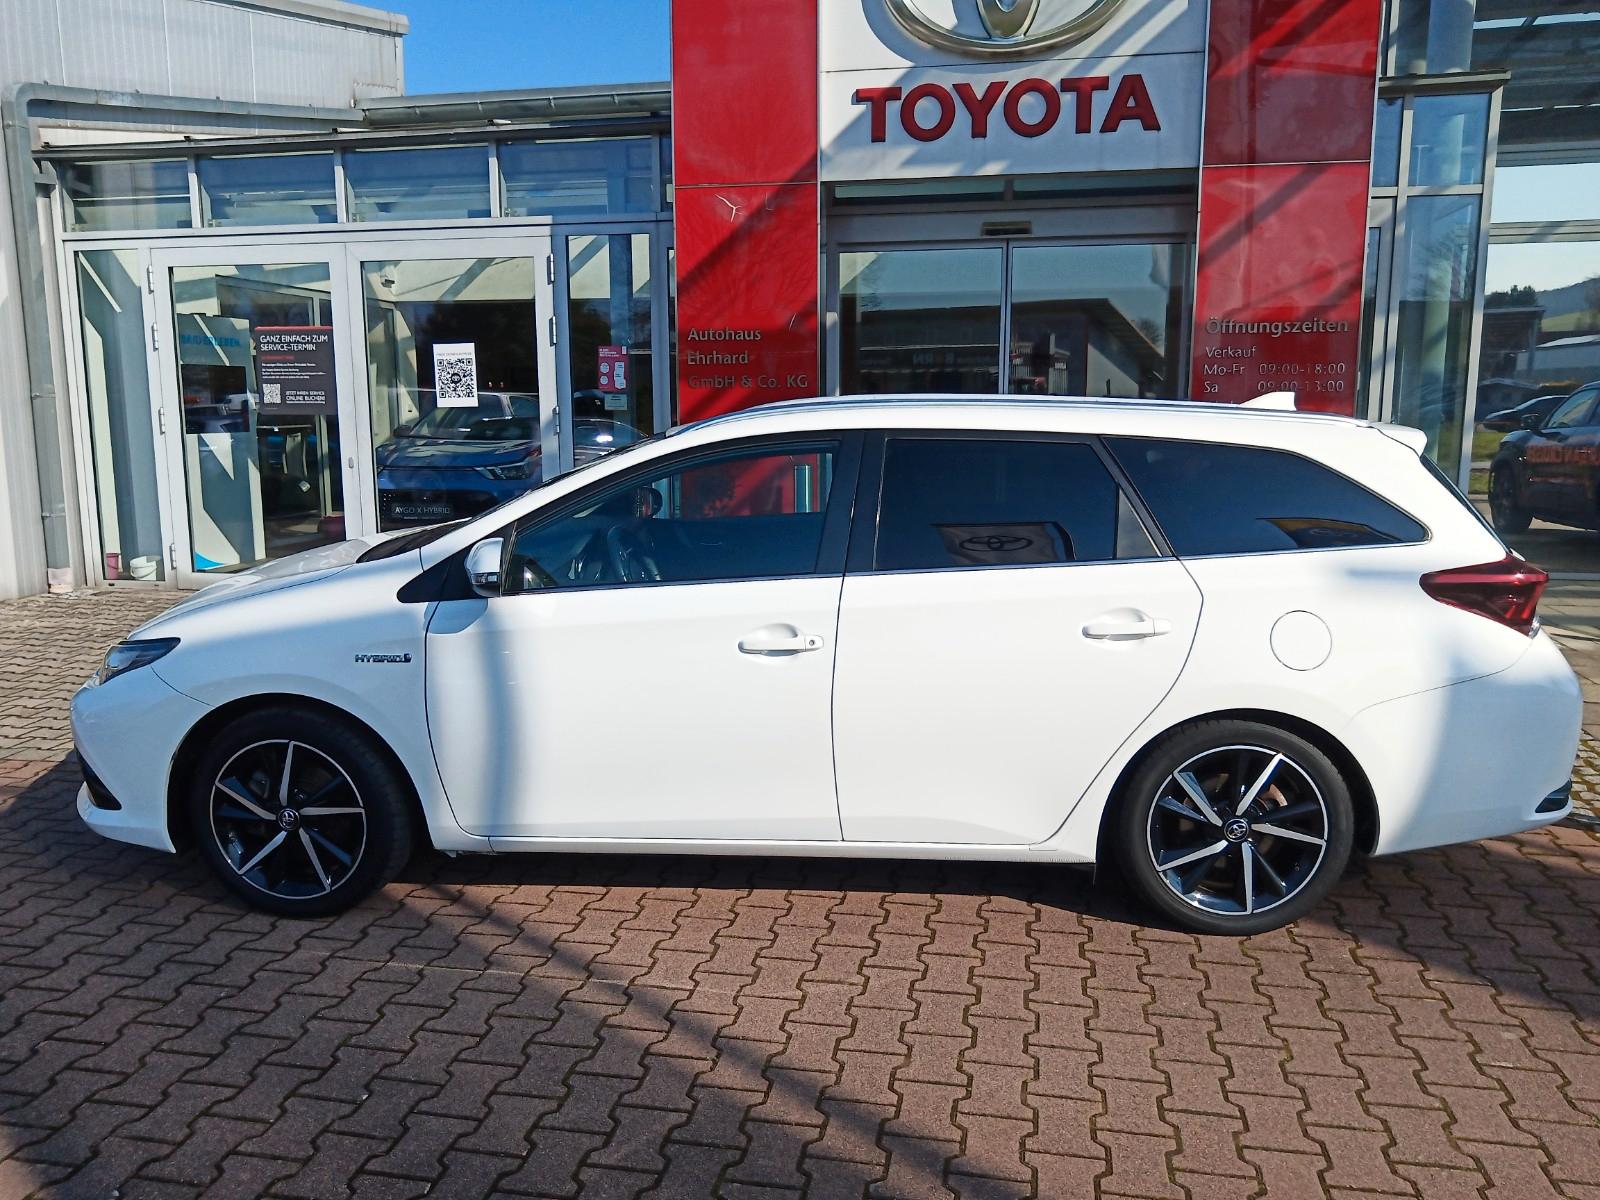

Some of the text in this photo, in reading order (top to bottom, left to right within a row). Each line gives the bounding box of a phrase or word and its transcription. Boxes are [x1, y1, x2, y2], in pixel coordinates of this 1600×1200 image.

[855, 74, 1161, 142] TOYOTA
[1206, 317, 1348, 337] Öffnungszeiten
[260, 334, 328, 343] GANZ EINFACH ZUM
[687, 327, 761, 341] Autohaus
[260, 343, 316, 351] SERVICE-TERMIN
[1206, 346, 1256, 358] Verkauf
[687, 350, 748, 365] Ehrhard
[1203, 364, 1245, 376] Mo-Fr
[688, 374, 808, 388] GmbH & Co. KG
[1203, 380, 1219, 393] Sa
[394, 506, 415, 514] AYGO
